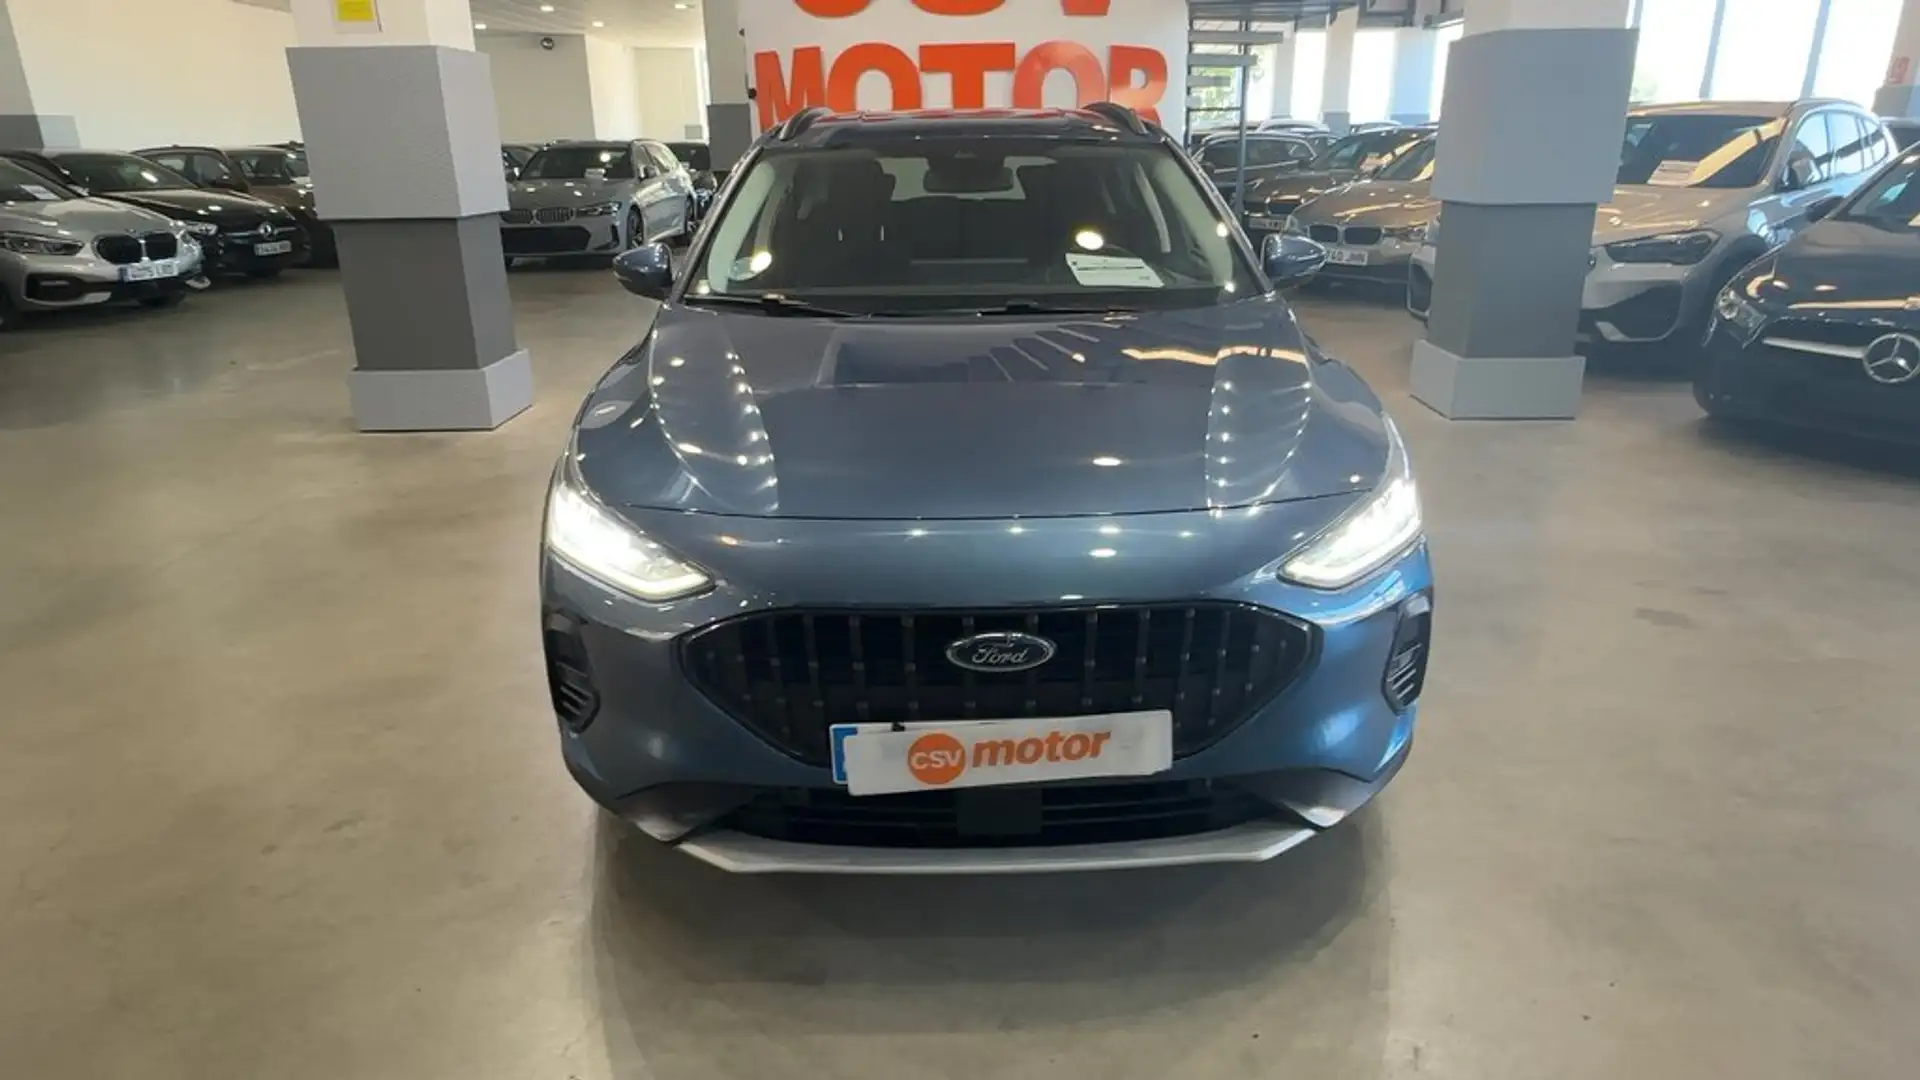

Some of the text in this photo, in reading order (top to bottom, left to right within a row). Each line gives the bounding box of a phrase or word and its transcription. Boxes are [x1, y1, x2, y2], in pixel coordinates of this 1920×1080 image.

[754, 42, 1169, 131] MOTOR
[972, 647, 1029, 664] Ford
[972, 731, 1112, 767] motor
